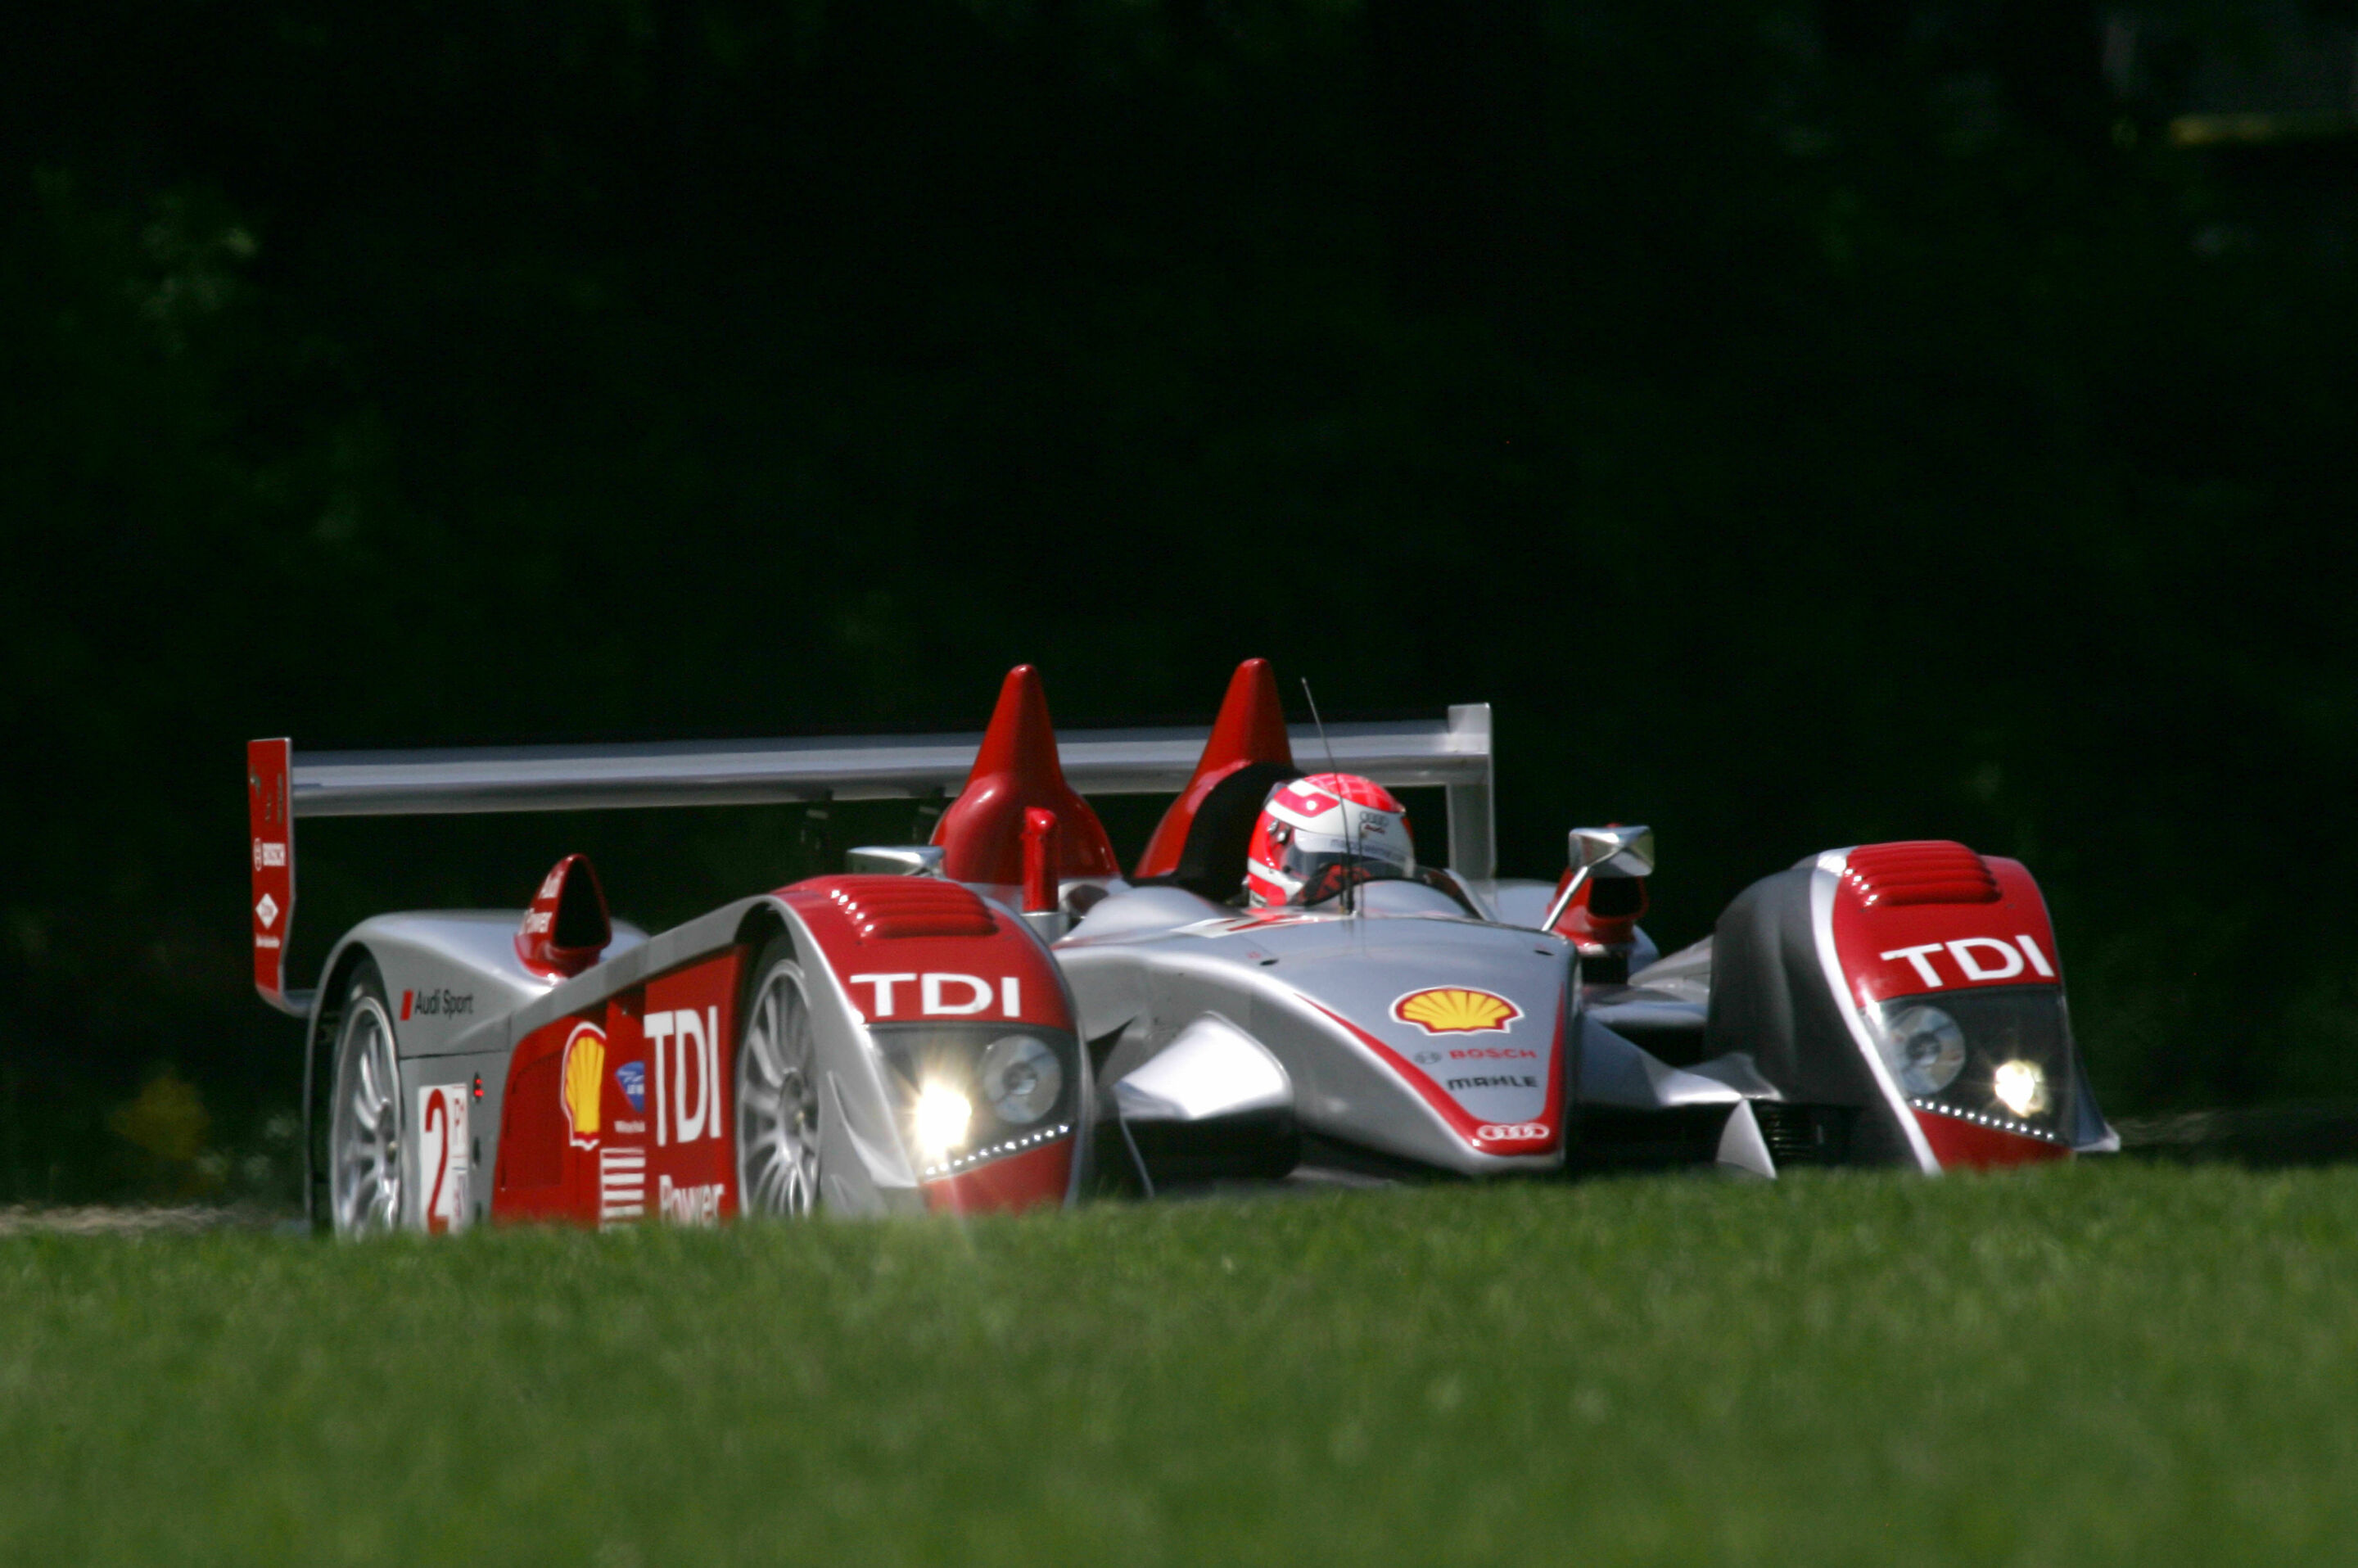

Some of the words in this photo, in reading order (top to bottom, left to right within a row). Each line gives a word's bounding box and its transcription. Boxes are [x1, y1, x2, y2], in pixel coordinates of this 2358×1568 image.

[1881, 935, 2054, 987] TDI
[414, 988, 440, 1014] Audi
[442, 988, 474, 1019] Sport
[850, 972, 1022, 1018] TDI
[644, 1006, 722, 1146] TDI
[1449, 1048, 1537, 1060] BOSCH
[1447, 1075, 1537, 1090] MAHLE
[425, 1088, 449, 1235] 2
[658, 1174, 725, 1227] Power
